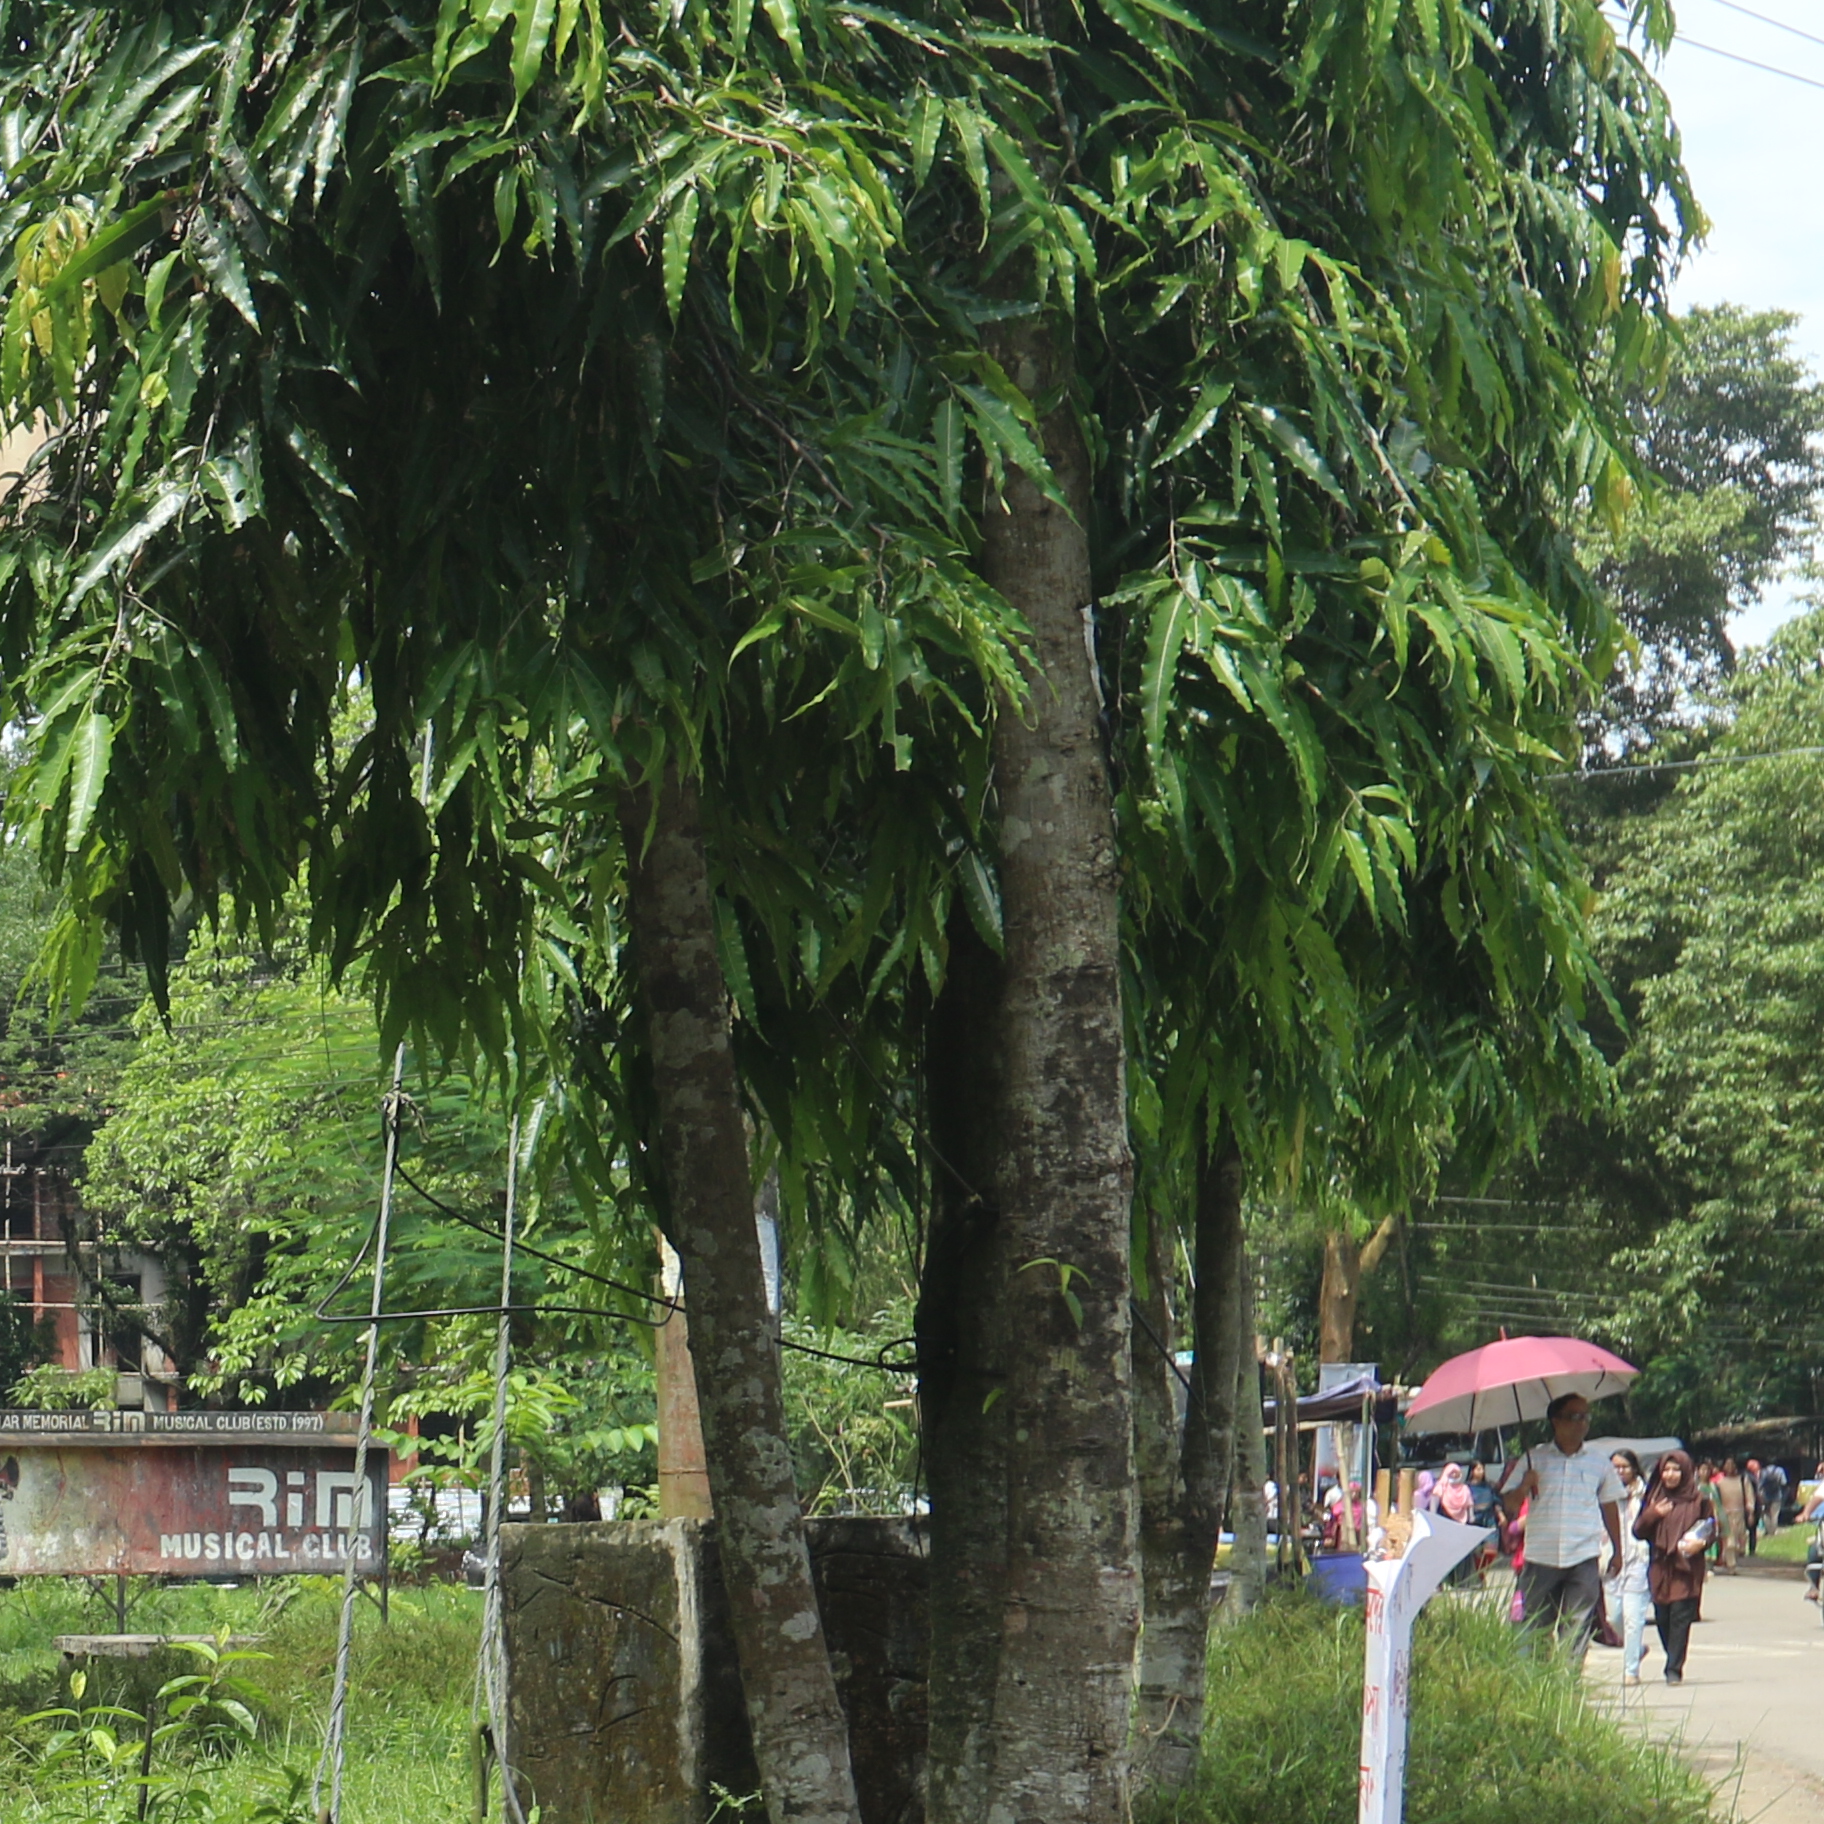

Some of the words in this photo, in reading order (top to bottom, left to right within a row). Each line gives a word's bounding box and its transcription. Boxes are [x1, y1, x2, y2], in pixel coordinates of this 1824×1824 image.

[23, 1414, 89, 1430] MEMORIAL
[153, 1415, 213, 1430] MUSICAL
[160, 1531, 290, 1560] MUSICAL
[302, 1533, 372, 1560] CLUB
